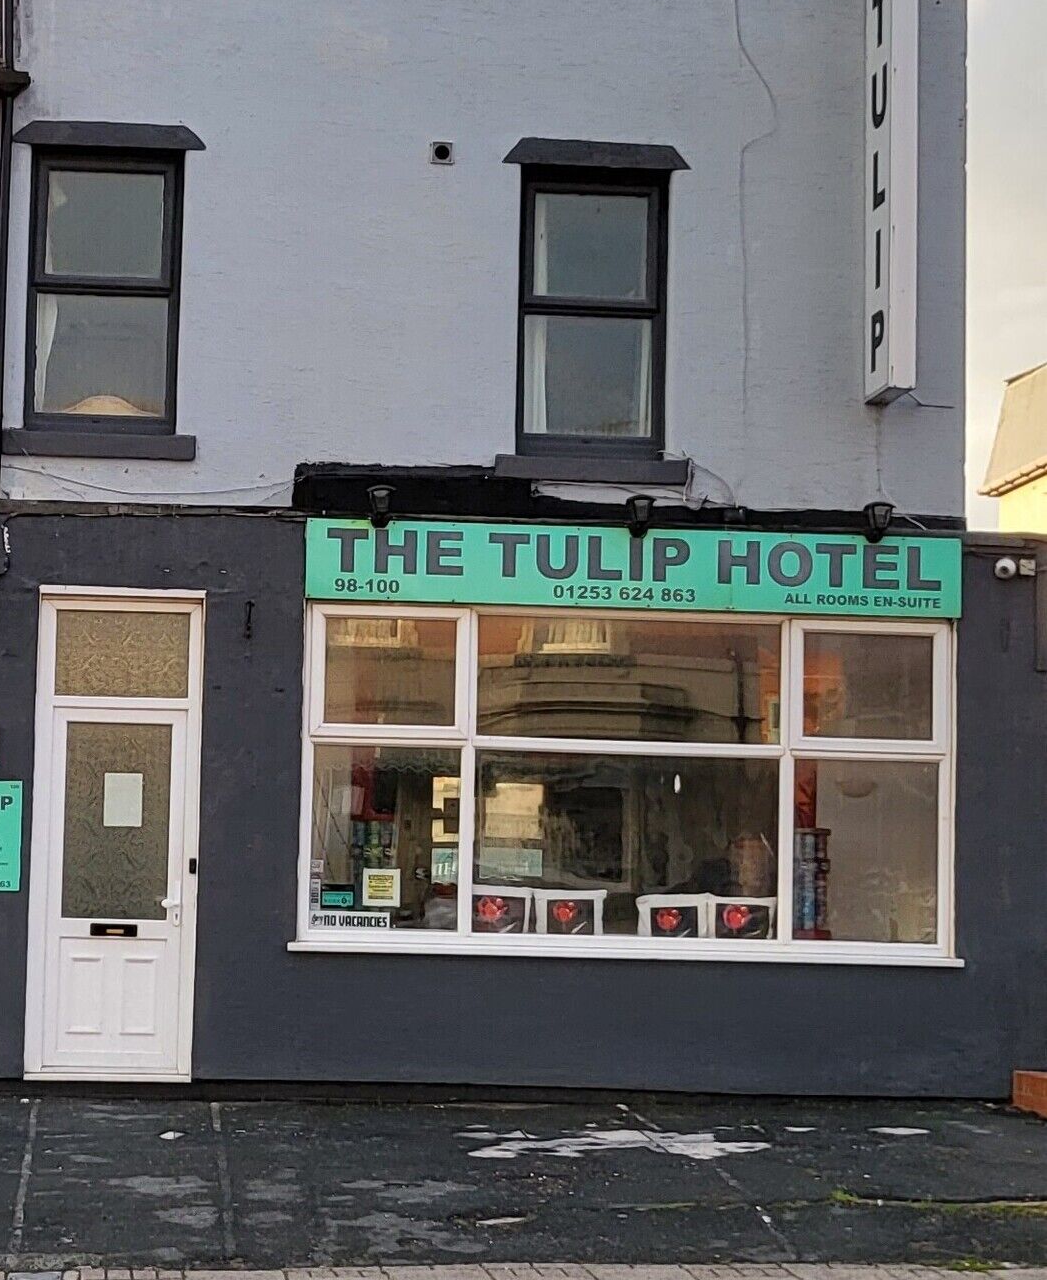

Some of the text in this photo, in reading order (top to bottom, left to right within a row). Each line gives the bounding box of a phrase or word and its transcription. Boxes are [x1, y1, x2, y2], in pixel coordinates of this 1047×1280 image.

[326, 527, 942, 592] THE TULIP HOTEL
[334, 578, 400, 594] 98-100
[553, 584, 696, 603] 01253 624 863
[784, 592, 941, 609] ALL ROOMS EN-SUITE
[324, 915, 337, 927] NO
[338, 915, 388, 928] VACANCIES
